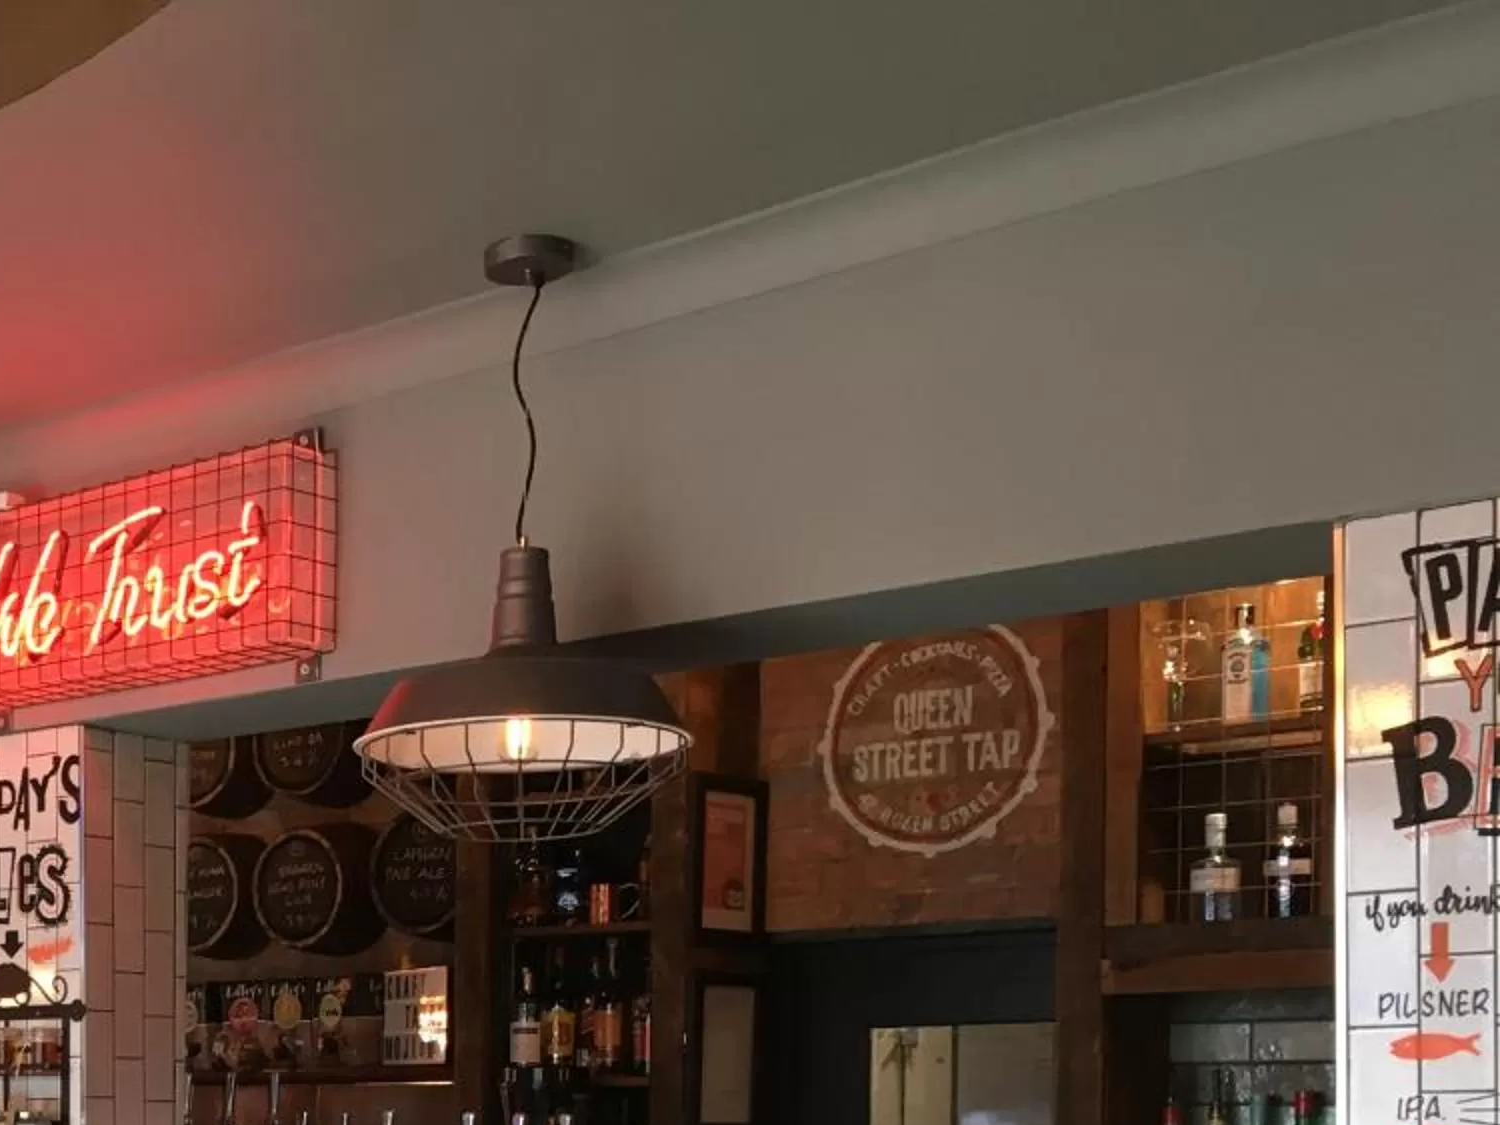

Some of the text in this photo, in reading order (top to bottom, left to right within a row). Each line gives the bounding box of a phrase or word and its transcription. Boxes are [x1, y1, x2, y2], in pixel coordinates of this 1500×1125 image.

[85, 500, 266, 648] Trust
[1454, 654, 1500, 712] Y
[893, 685, 973, 734] QUEEN
[852, 730, 1022, 783] STREET TAP
[1365, 893, 1385, 932] if
[1386, 898, 1428, 929] you
[1378, 989, 1490, 1019] PILSNER
